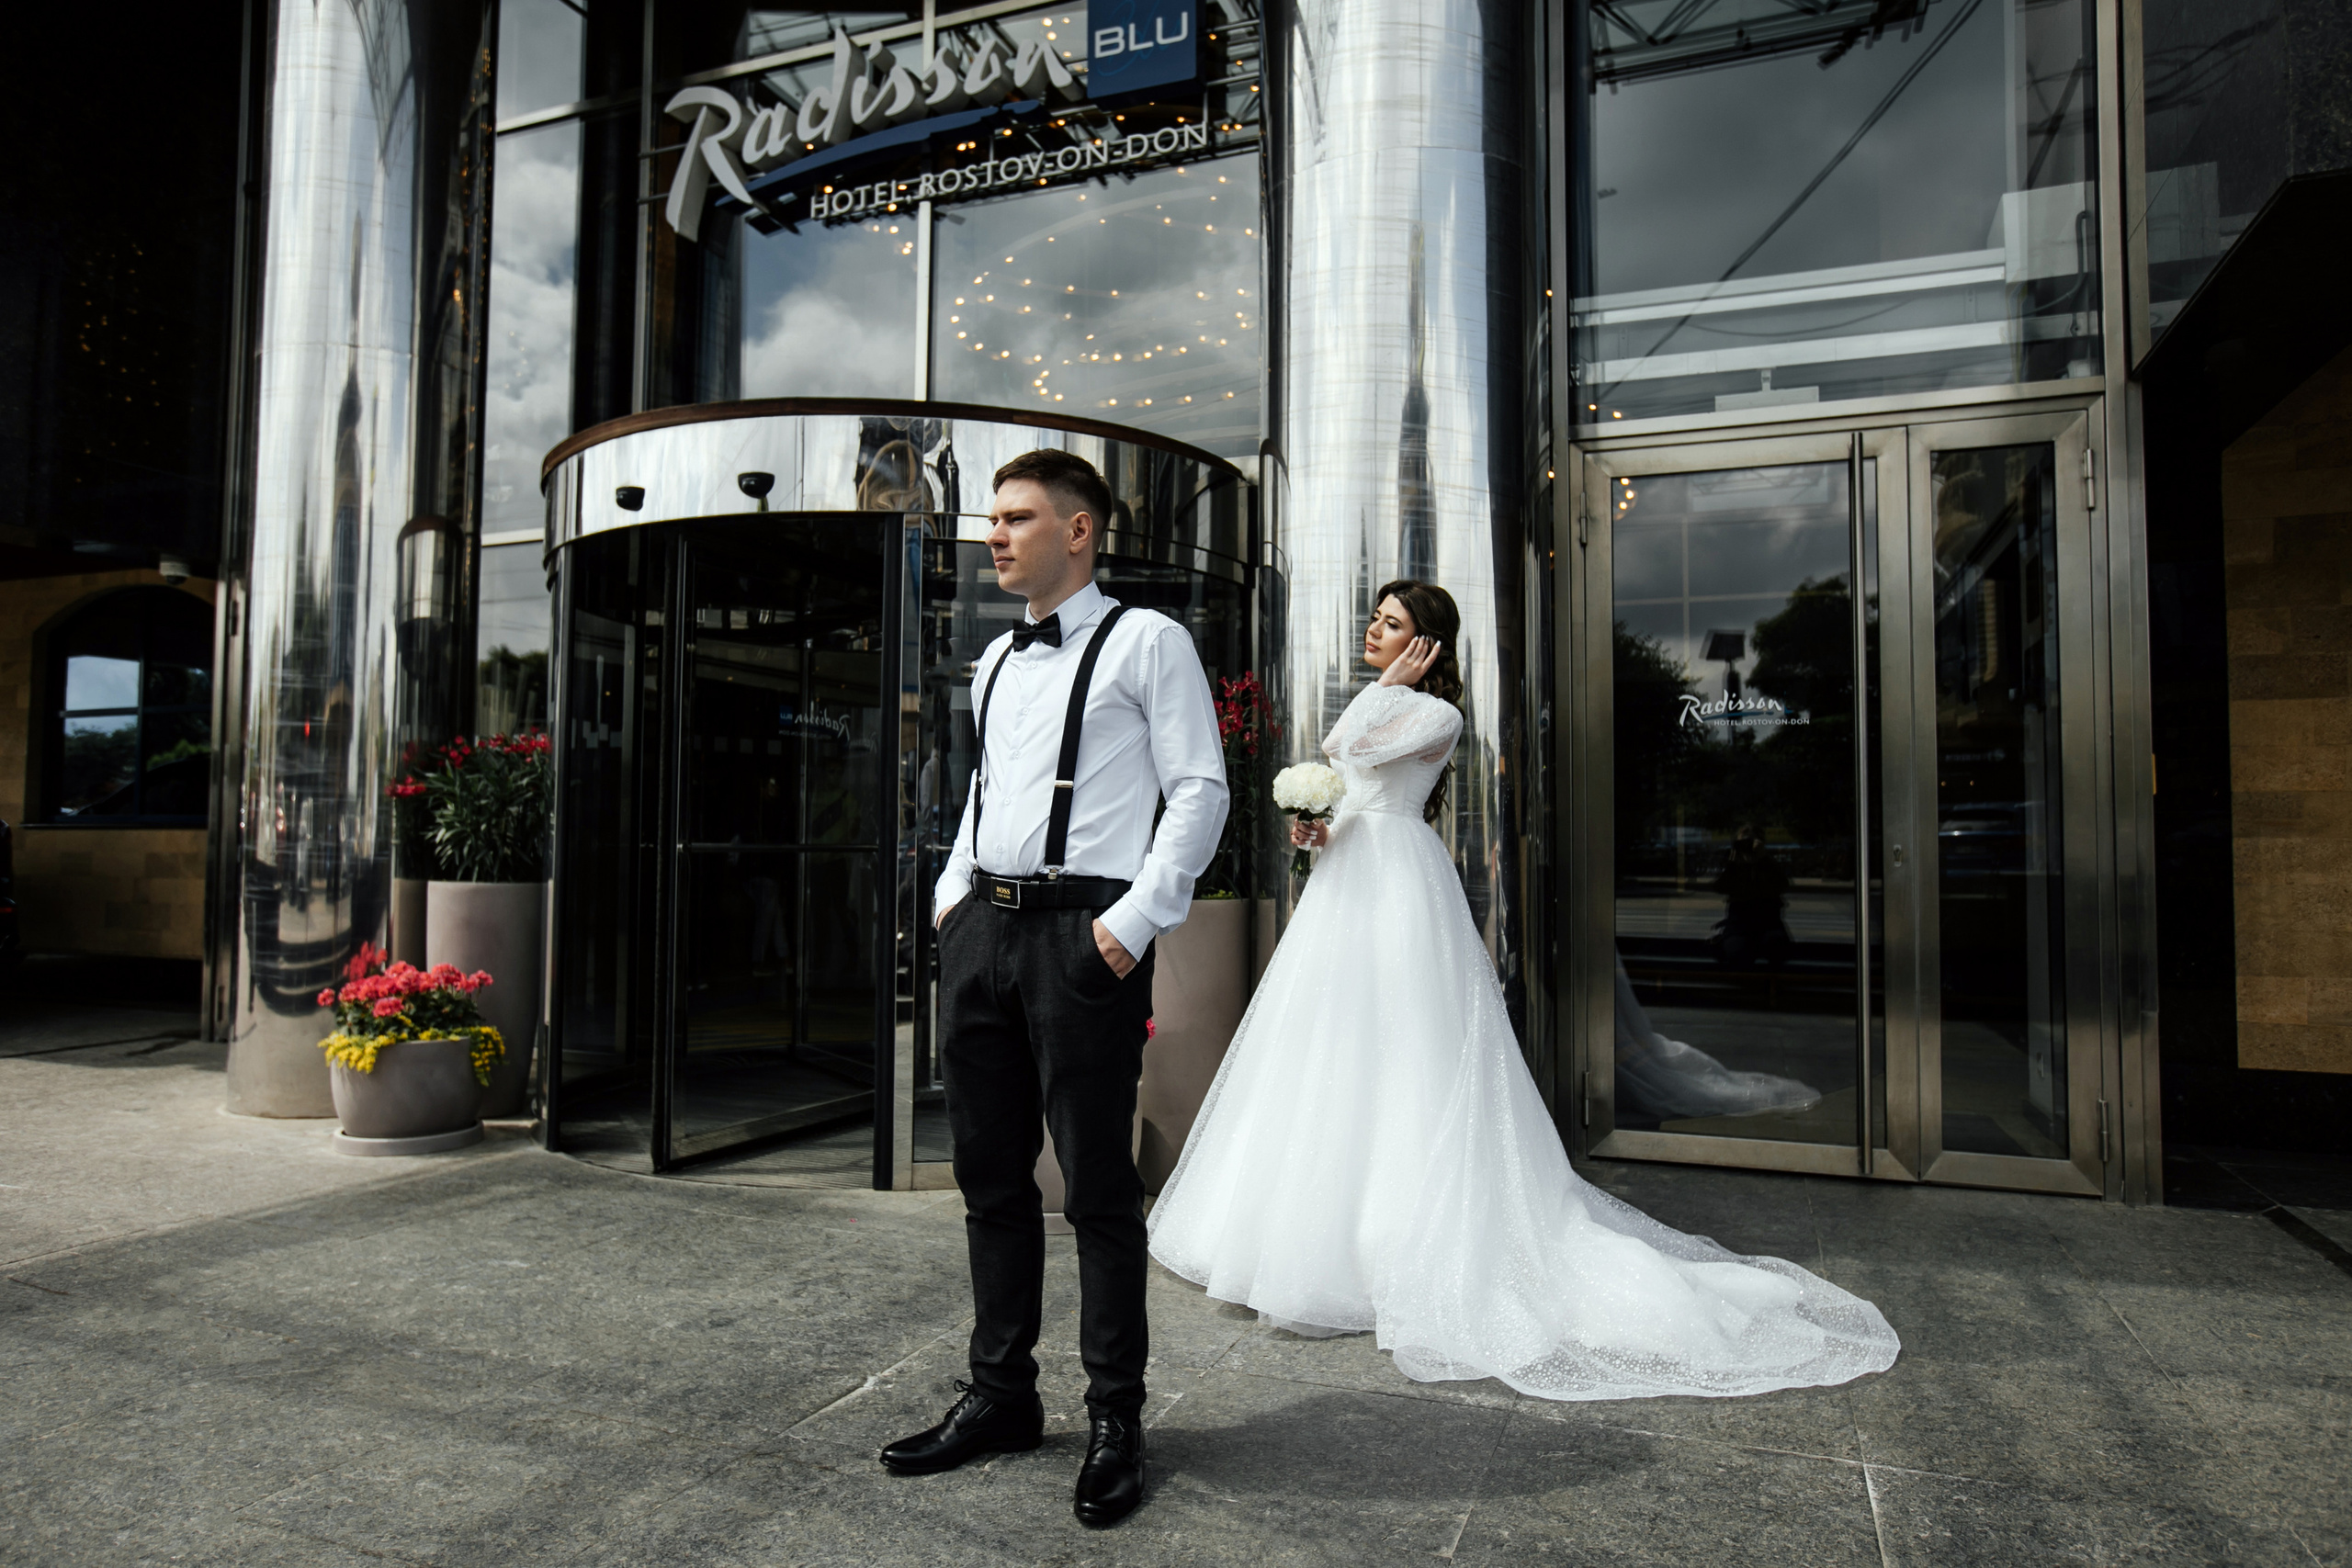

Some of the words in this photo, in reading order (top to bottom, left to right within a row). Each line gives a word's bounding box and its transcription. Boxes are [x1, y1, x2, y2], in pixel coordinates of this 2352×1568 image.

[664, 27, 1075, 241] Radisson
[1094, 11, 1188, 59] BLU
[920, 121, 1208, 199] ROSTOV-ON-DON
[1679, 689, 1782, 727] Radisson
[996, 886, 1011, 896] BOSS
